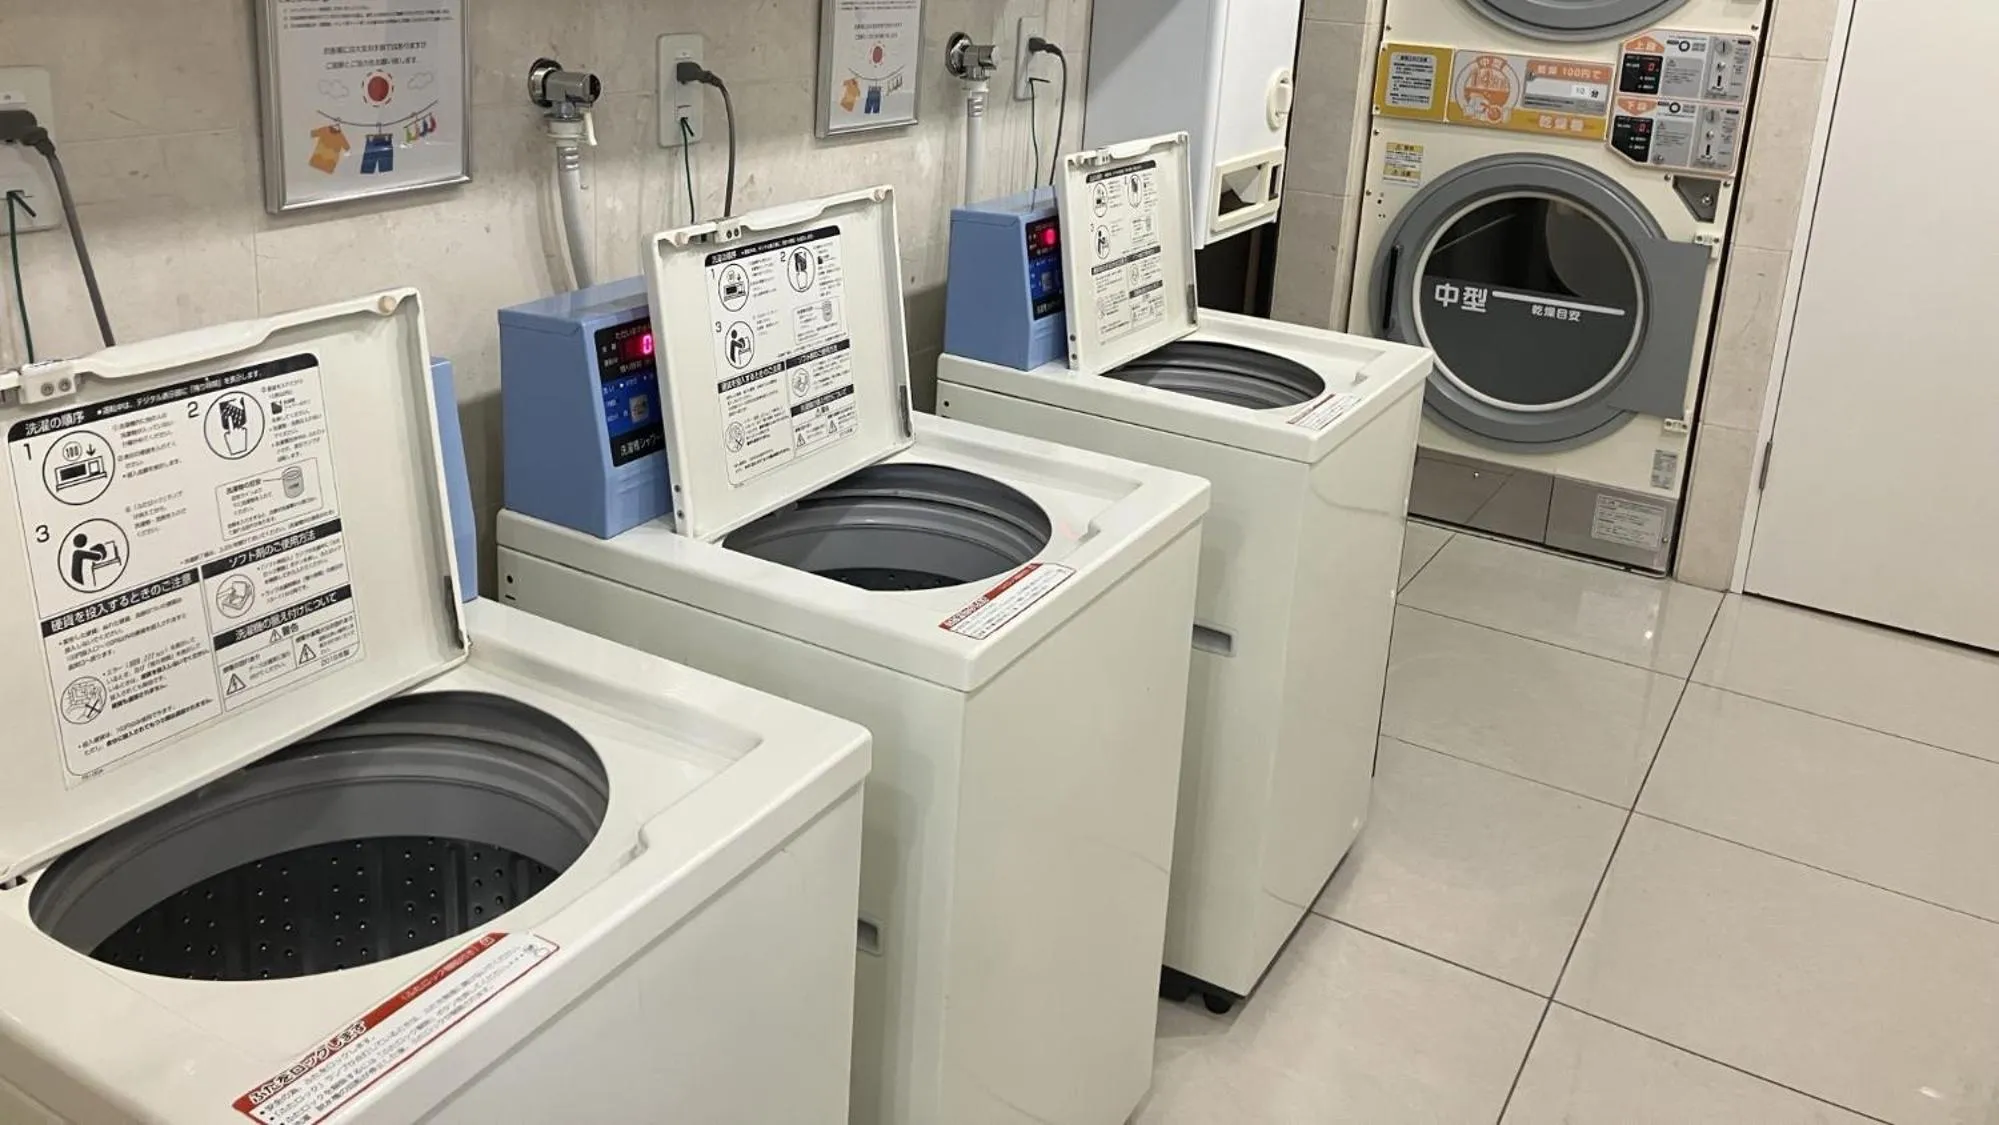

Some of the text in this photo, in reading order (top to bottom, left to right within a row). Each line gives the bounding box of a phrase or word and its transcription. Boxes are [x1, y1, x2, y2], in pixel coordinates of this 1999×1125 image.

[780, 251, 786, 262] 2
[710, 269, 716, 279] 1
[1434, 283, 1488, 313] 中型
[1531, 304, 1581, 322] 乾燥目安
[715, 321, 722, 333] 3
[642, 334, 653, 354] 0
[186, 399, 200, 418] 2
[23, 409, 85, 436] 洗濯の順序
[22, 442, 33, 461] 1
[34, 523, 50, 544] 3
[228, 530, 315, 568] ソフト剤のご使用方法
[50, 571, 192, 632] 硬貨を投入するときのご注意
[250, 1019, 367, 1104] ふたをロックします
